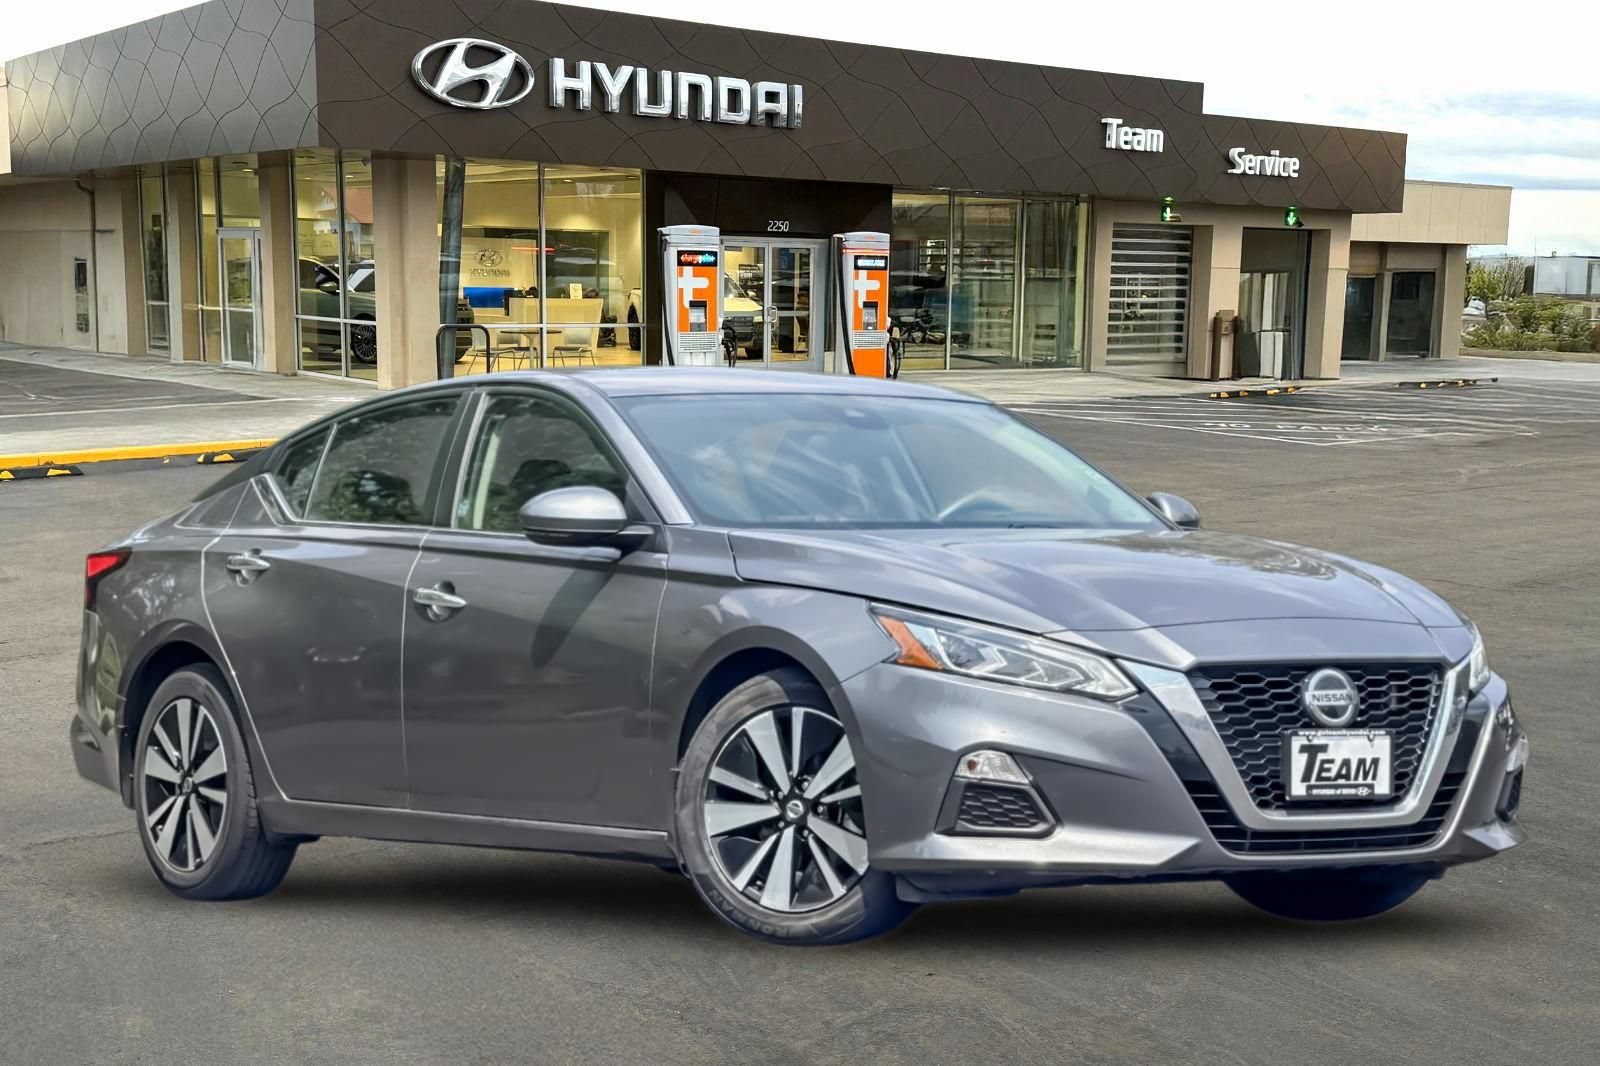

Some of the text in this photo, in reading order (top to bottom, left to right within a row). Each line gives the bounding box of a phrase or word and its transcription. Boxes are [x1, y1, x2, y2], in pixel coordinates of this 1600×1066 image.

[549, 57, 803, 129] HYUNDAI
[1101, 117, 1164, 152] Team
[1227, 147, 1300, 177] Service
[767, 220, 790, 232] 2250
[1311, 693, 1353, 703] NISSAN
[1298, 743, 1380, 783] TEAM
